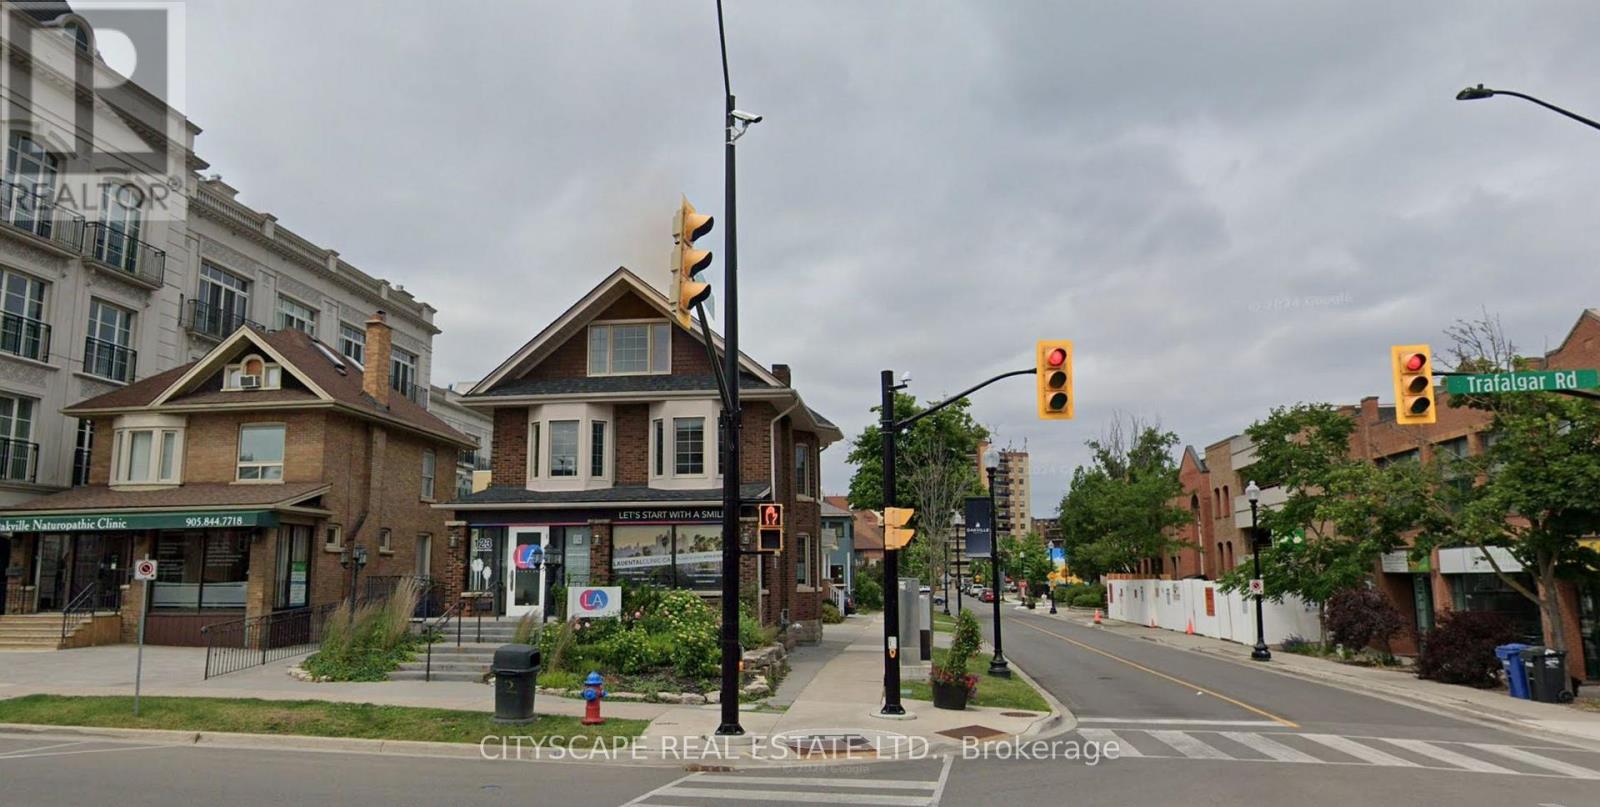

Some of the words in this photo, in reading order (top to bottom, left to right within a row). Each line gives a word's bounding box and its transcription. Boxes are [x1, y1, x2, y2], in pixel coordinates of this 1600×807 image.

[1467, 373, 1546, 393] Trafalgar
[1555, 371, 1578, 389] Rd
[185, 516, 243, 527] 905.844.7718
[619, 511, 641, 519] LET'S
[642, 511, 668, 519] START
[693, 510, 700, 518] A
[32, 518, 96, 532] Naturopathic
[97, 517, 127, 530] Clinic
[584, 590, 604, 607] LA
